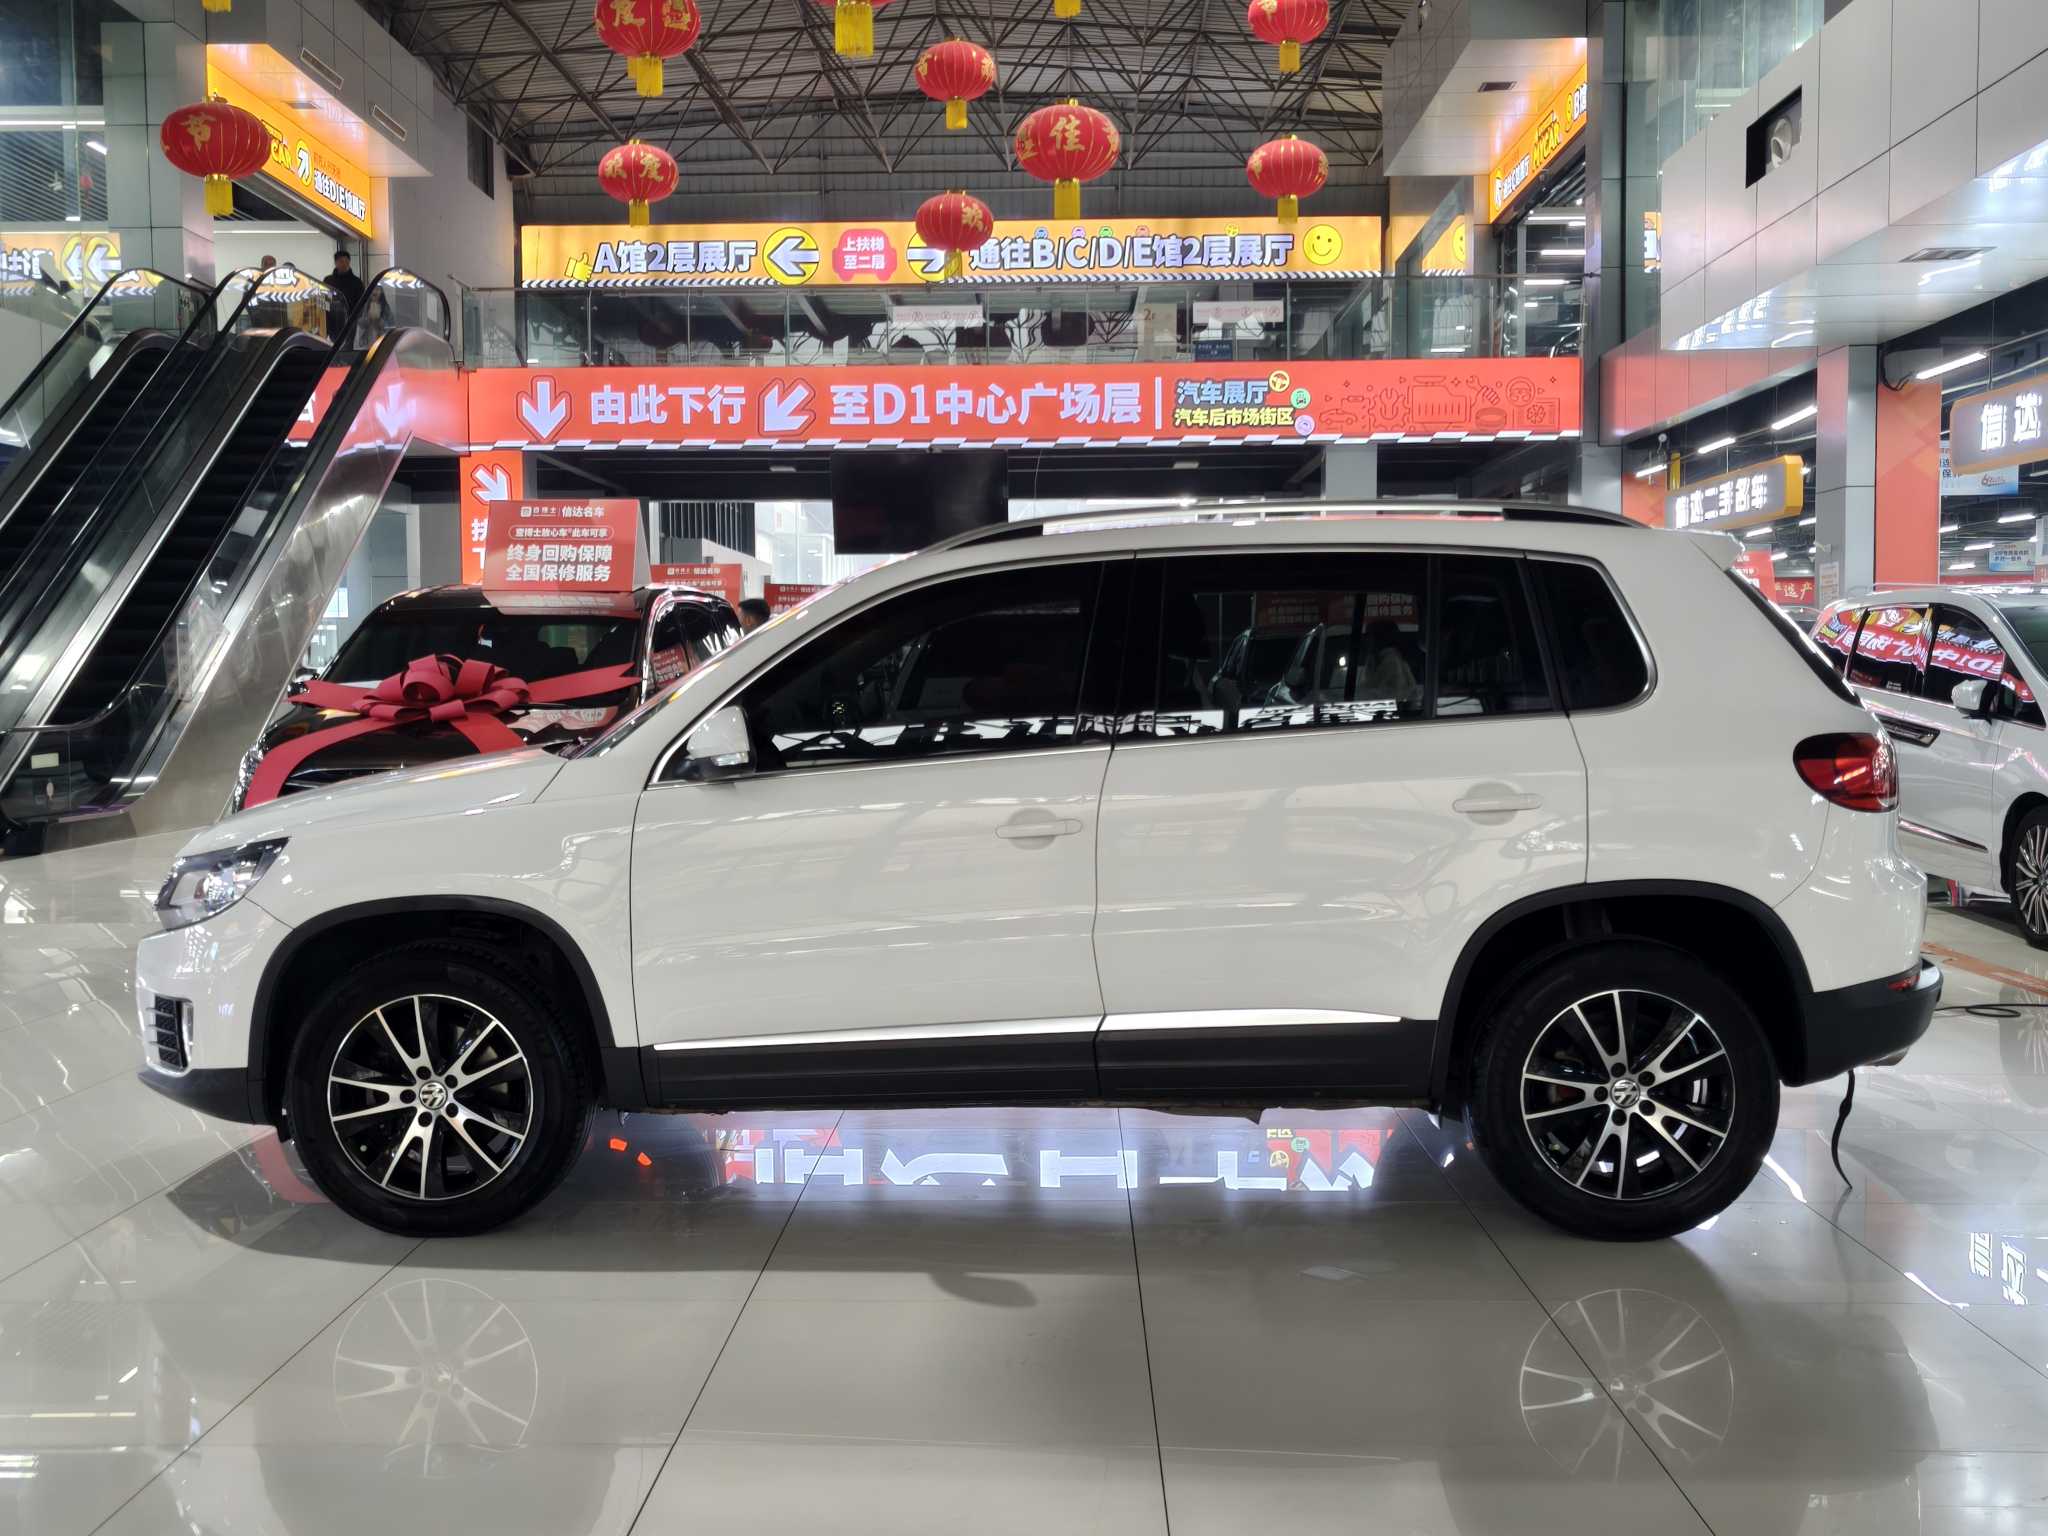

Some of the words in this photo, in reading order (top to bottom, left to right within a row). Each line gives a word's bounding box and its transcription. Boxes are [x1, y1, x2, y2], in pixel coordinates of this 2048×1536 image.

[843, 236, 885, 252] 上扶梯
[593, 240, 758, 274] A馆2层展厅
[843, 253, 886, 270] 至二层
[1176, 380, 1270, 405] 汽车展厅
[591, 384, 746, 425] 由此下行
[829, 383, 1141, 426] 至D1中心广场层
[1173, 406, 1295, 427] 汽车后市场街区
[1981, 392, 2042, 451] 信达
[506, 544, 613, 562] 终身回购保障
[506, 564, 611, 582] 全国保修服务
